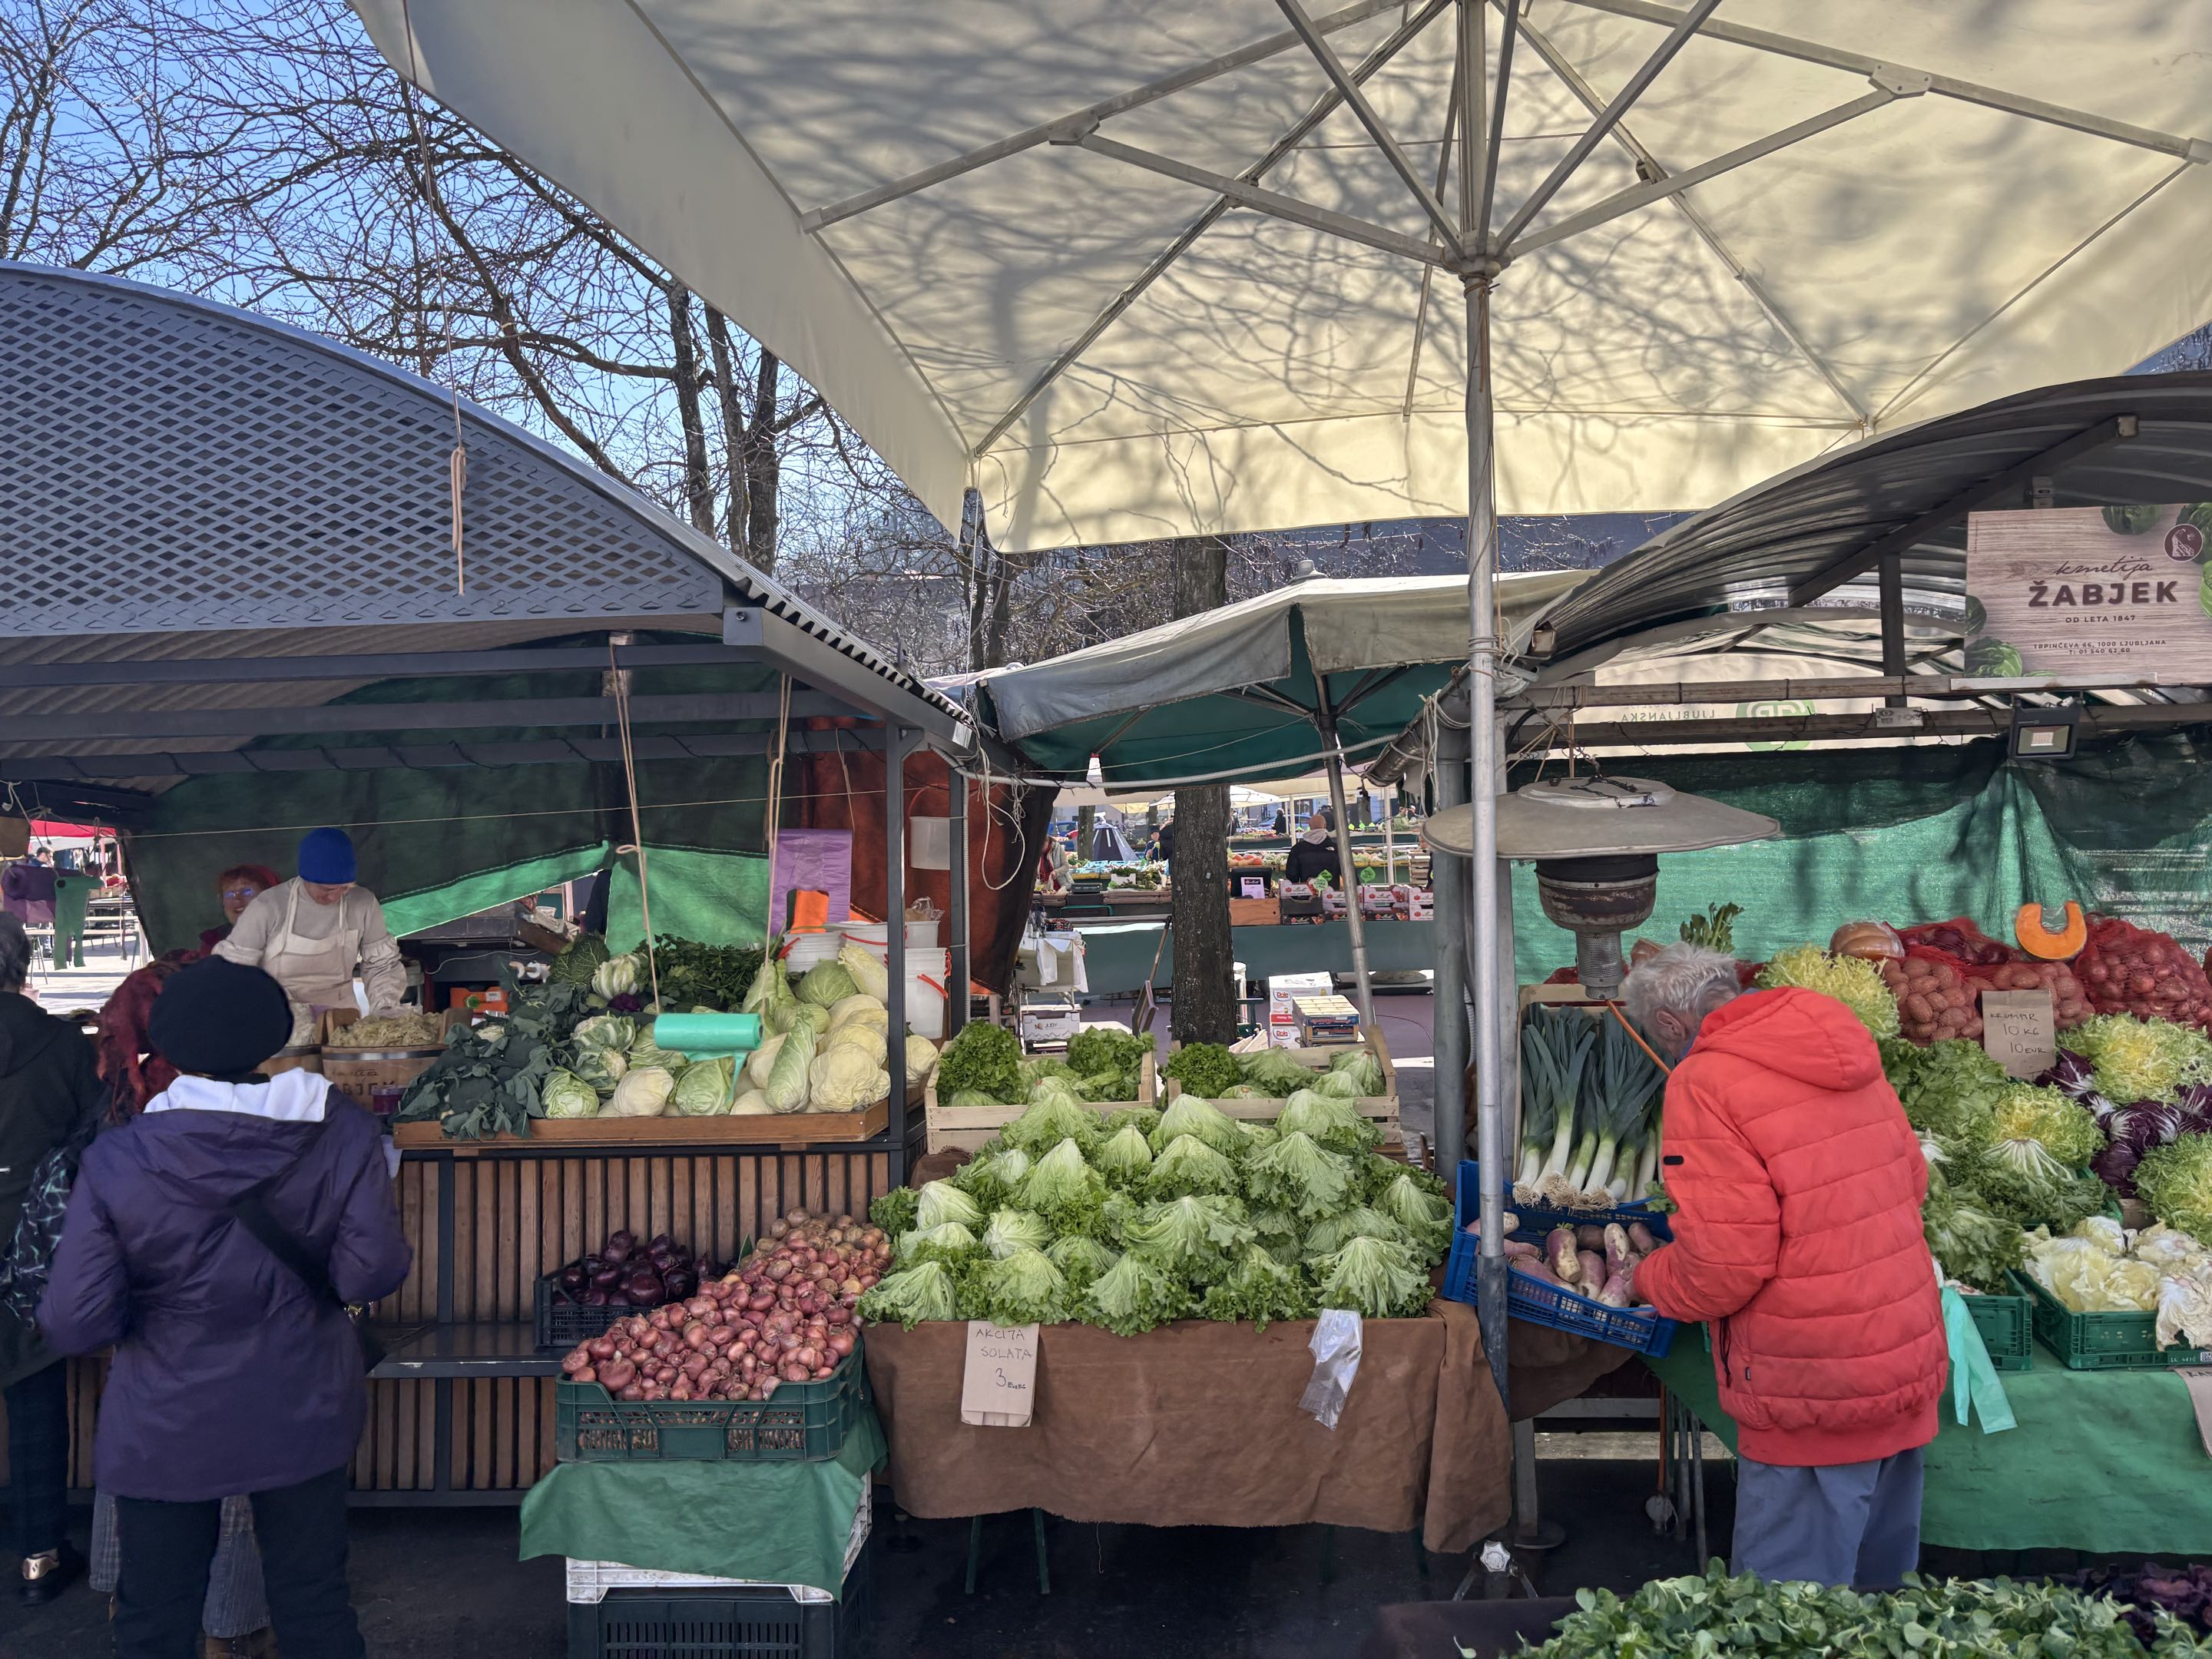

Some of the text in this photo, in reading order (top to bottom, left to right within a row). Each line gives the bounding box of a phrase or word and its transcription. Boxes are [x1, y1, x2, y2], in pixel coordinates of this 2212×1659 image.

[2053, 555, 2153, 581] kmetija
[2028, 580, 2178, 608] ŽABJEK
[2003, 1023, 2039, 1036] 10 KG
[981, 1346, 1034, 1360] SOLATA
